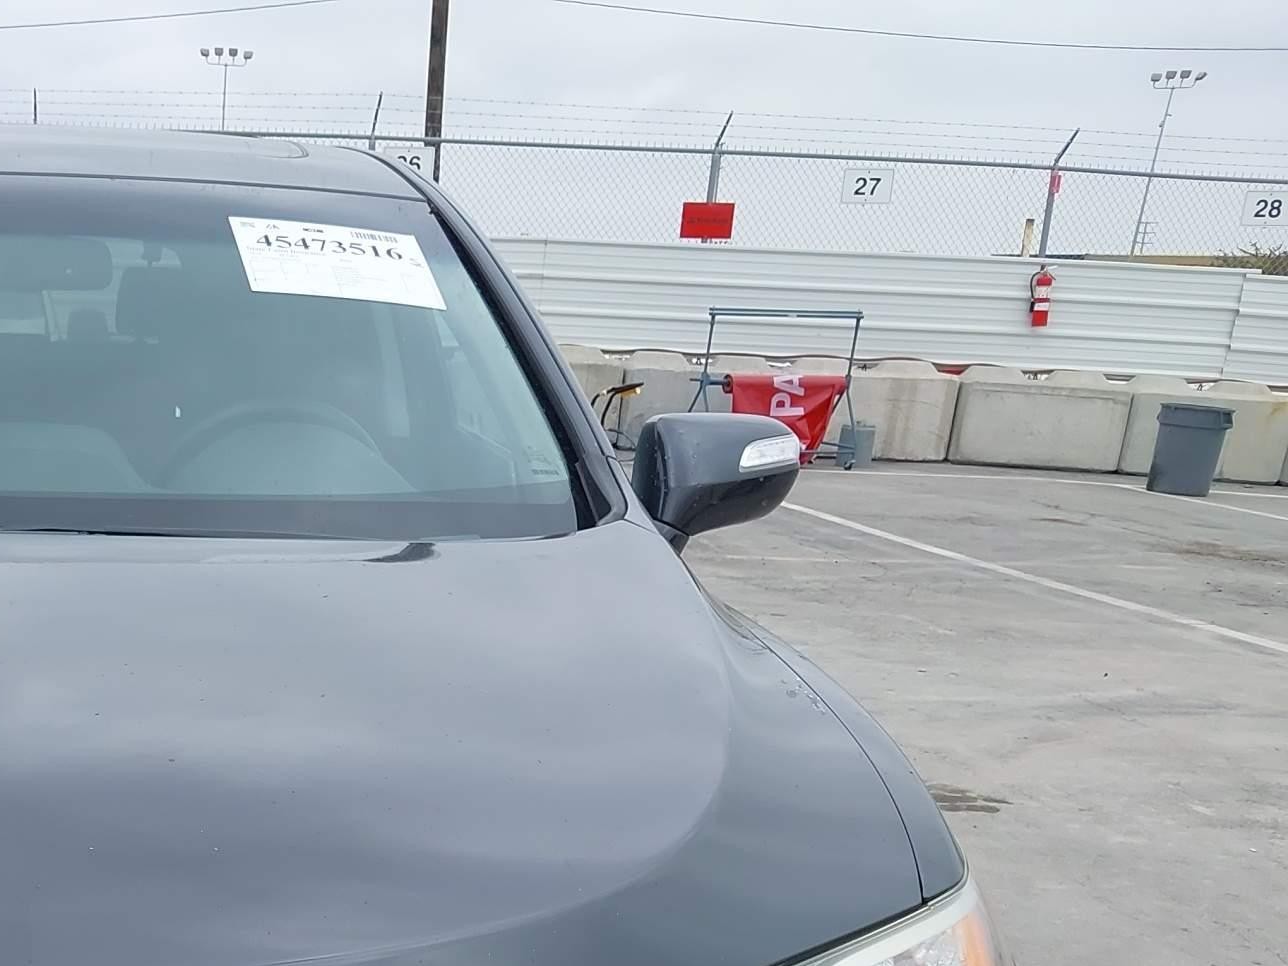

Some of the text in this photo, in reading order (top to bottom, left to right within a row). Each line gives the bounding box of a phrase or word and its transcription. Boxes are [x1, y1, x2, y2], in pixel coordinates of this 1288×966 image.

[853, 177, 882, 196] 27
[1253, 199, 1283, 218] 28
[256, 234, 403, 261] 45473516
